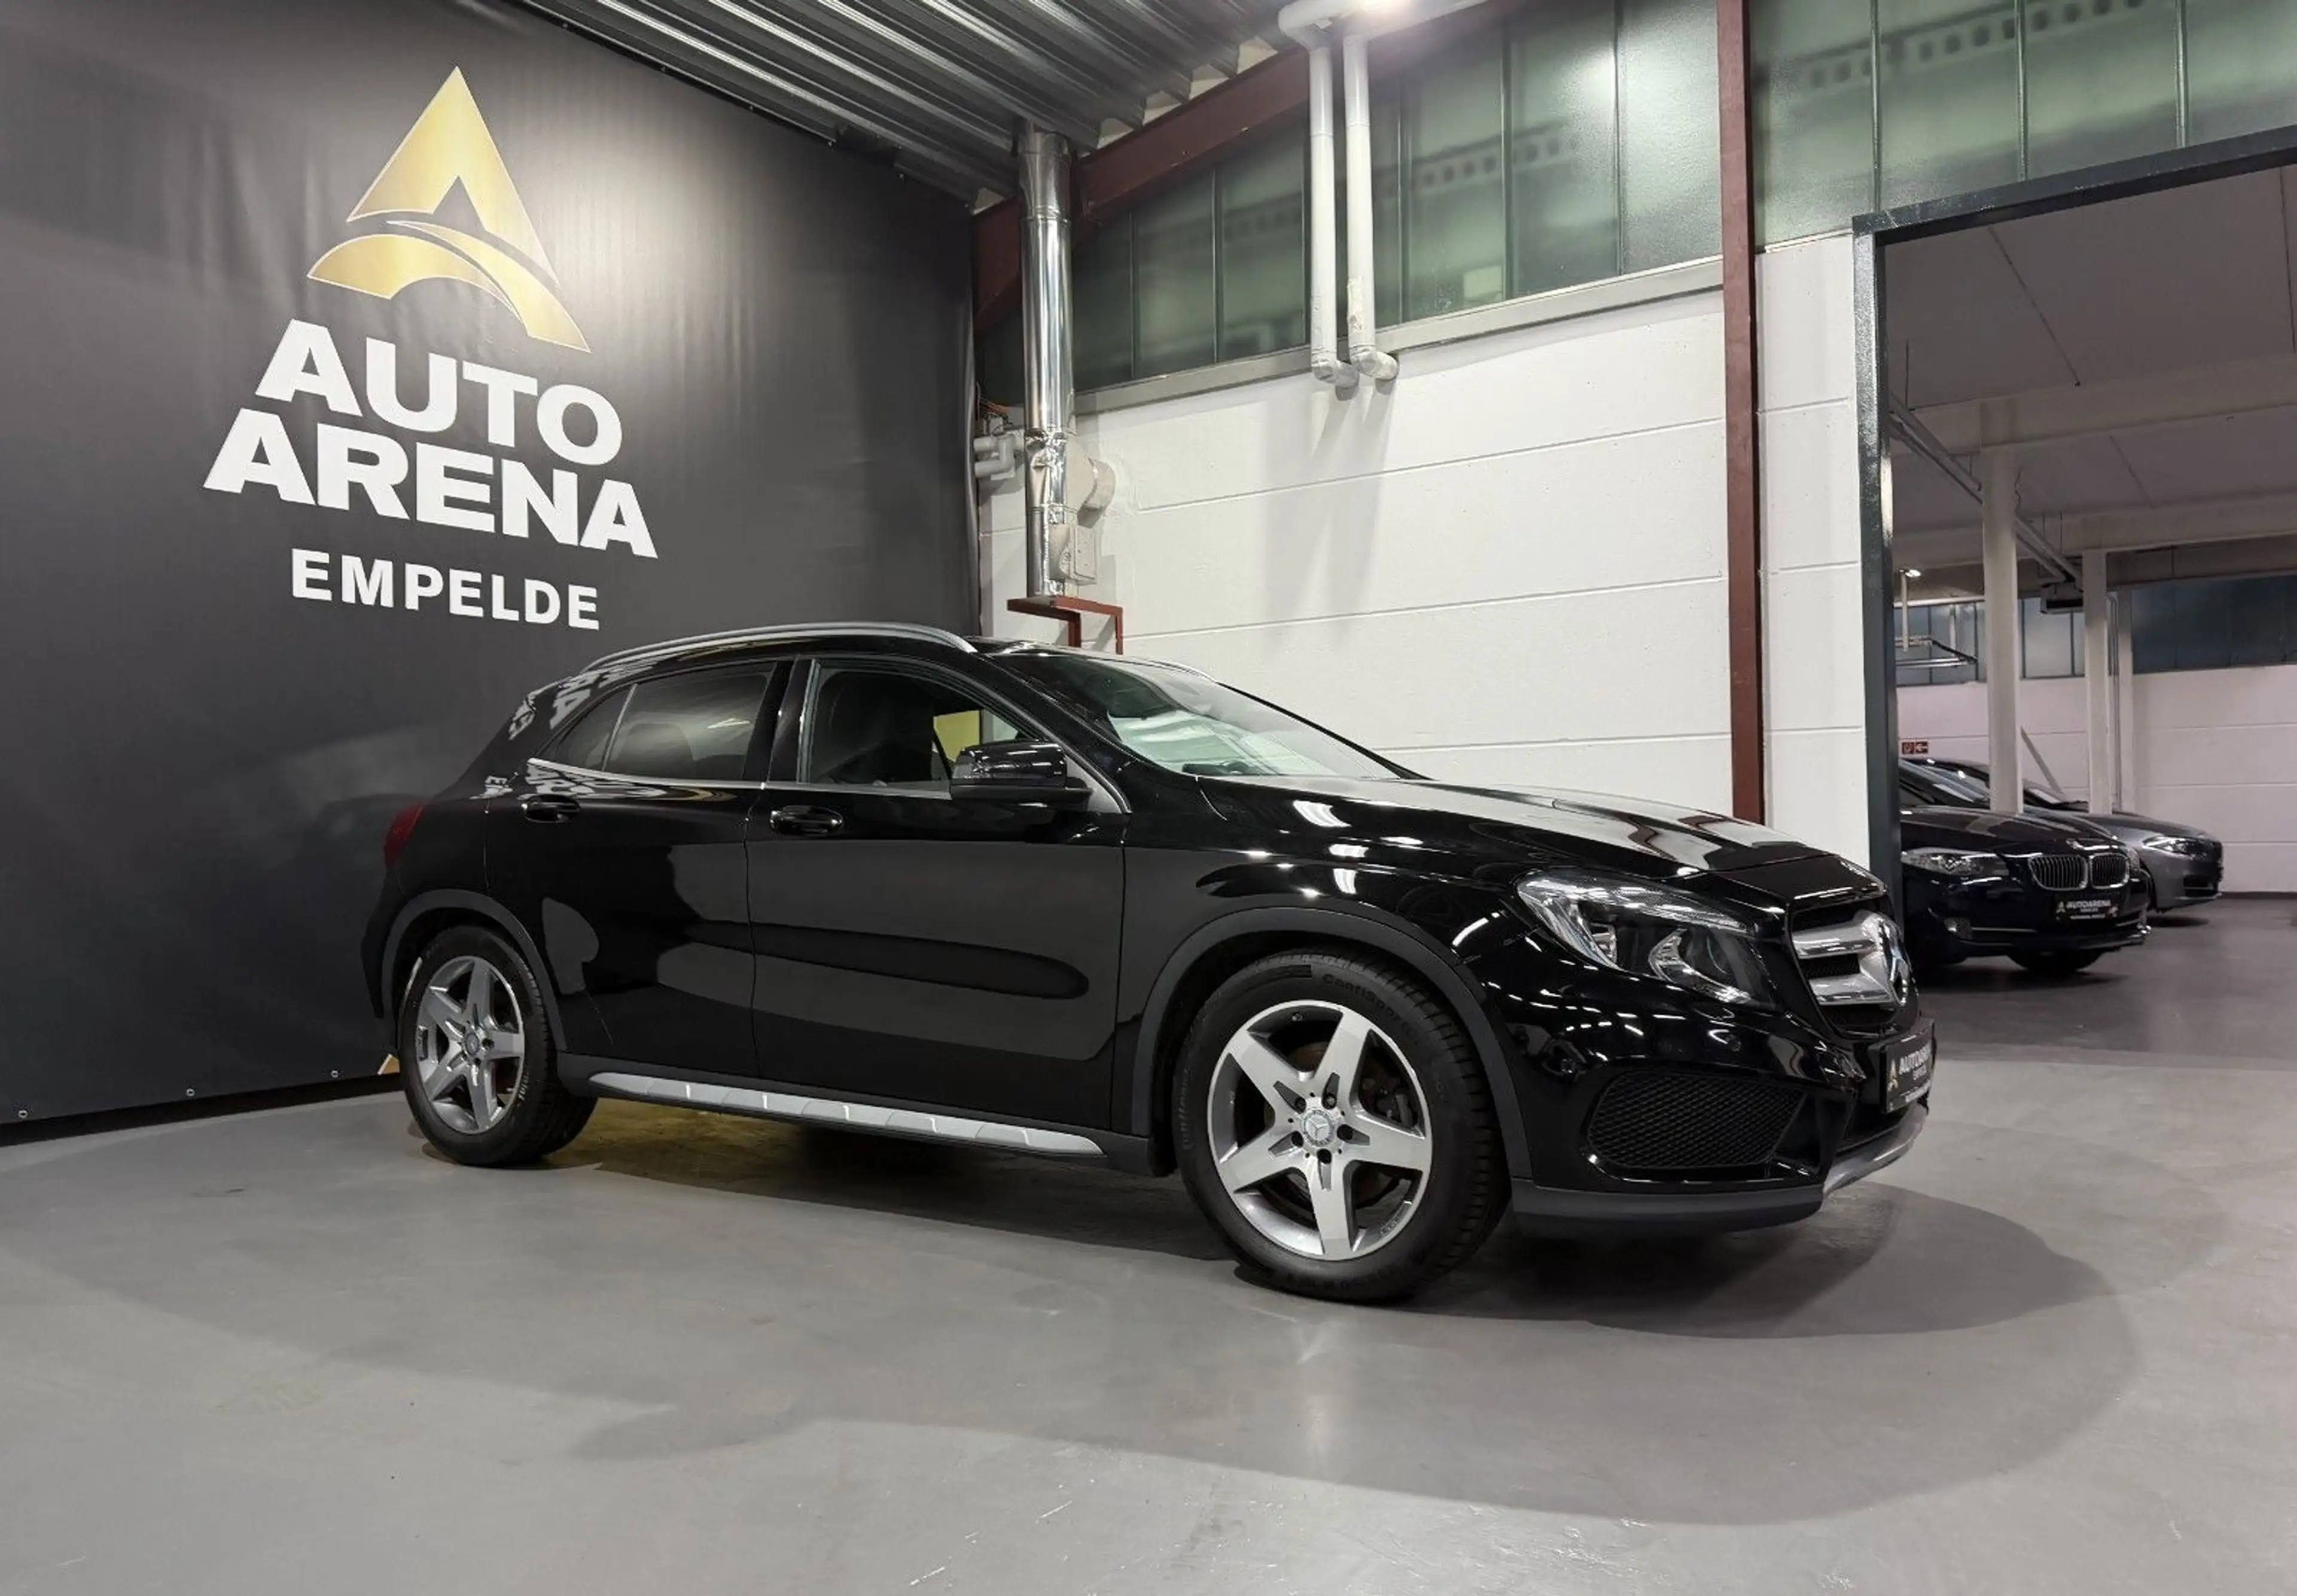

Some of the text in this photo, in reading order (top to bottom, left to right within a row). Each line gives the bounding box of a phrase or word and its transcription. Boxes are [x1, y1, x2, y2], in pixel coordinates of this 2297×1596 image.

[255, 319, 623, 465] AUTO
[203, 408, 659, 559] ARENA
[292, 549, 599, 631] EMPELDE
